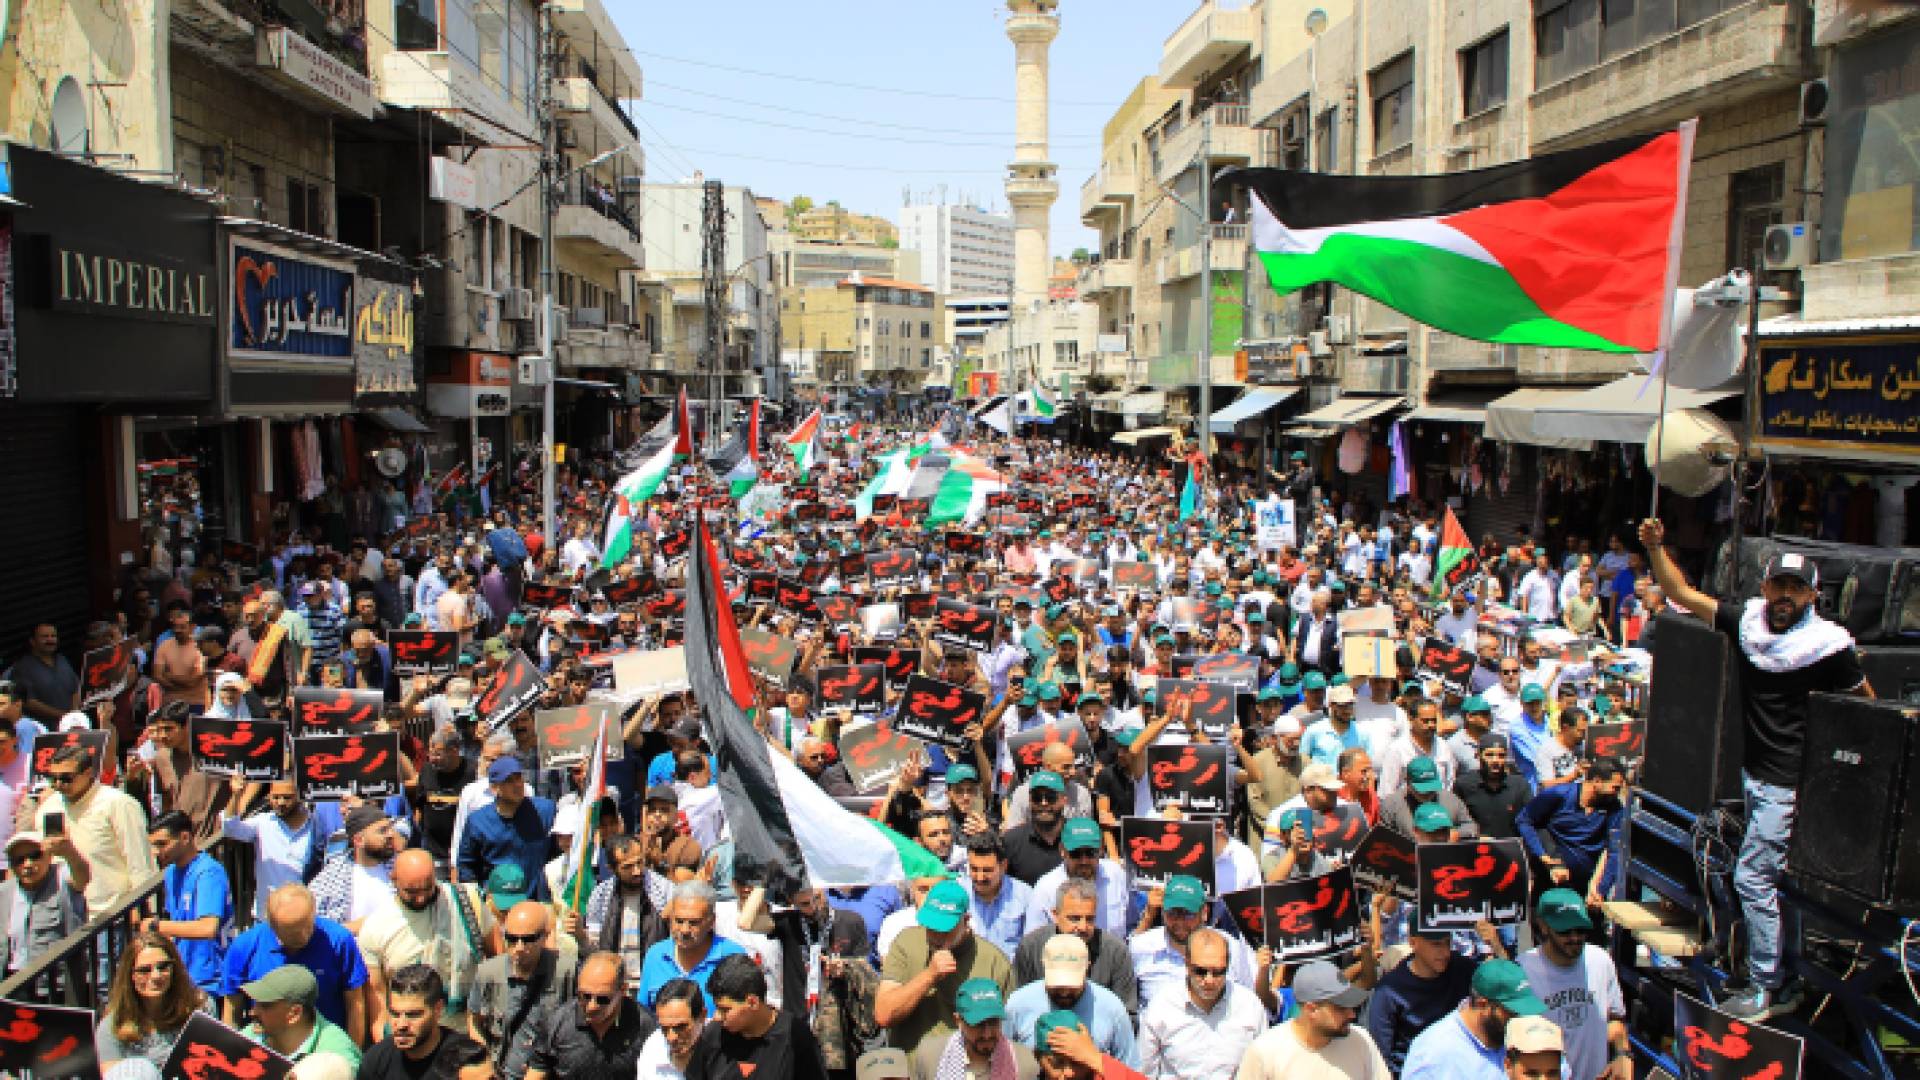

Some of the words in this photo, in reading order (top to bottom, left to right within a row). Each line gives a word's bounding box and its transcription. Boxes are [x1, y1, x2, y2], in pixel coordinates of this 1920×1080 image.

[60, 249, 213, 317] IMPERIAL
[822, 666, 880, 700] رفح
[302, 691, 373, 724] رفح
[909, 688, 976, 725] رفح
[197, 723, 276, 757] رفح
[304, 737, 388, 780] رفح
[1151, 746, 1220, 789] رفح
[1128, 822, 1206, 868] رفح
[1431, 844, 1519, 899] رفح
[1275, 876, 1351, 934] رفح
[0, 1008, 78, 1064] رف
